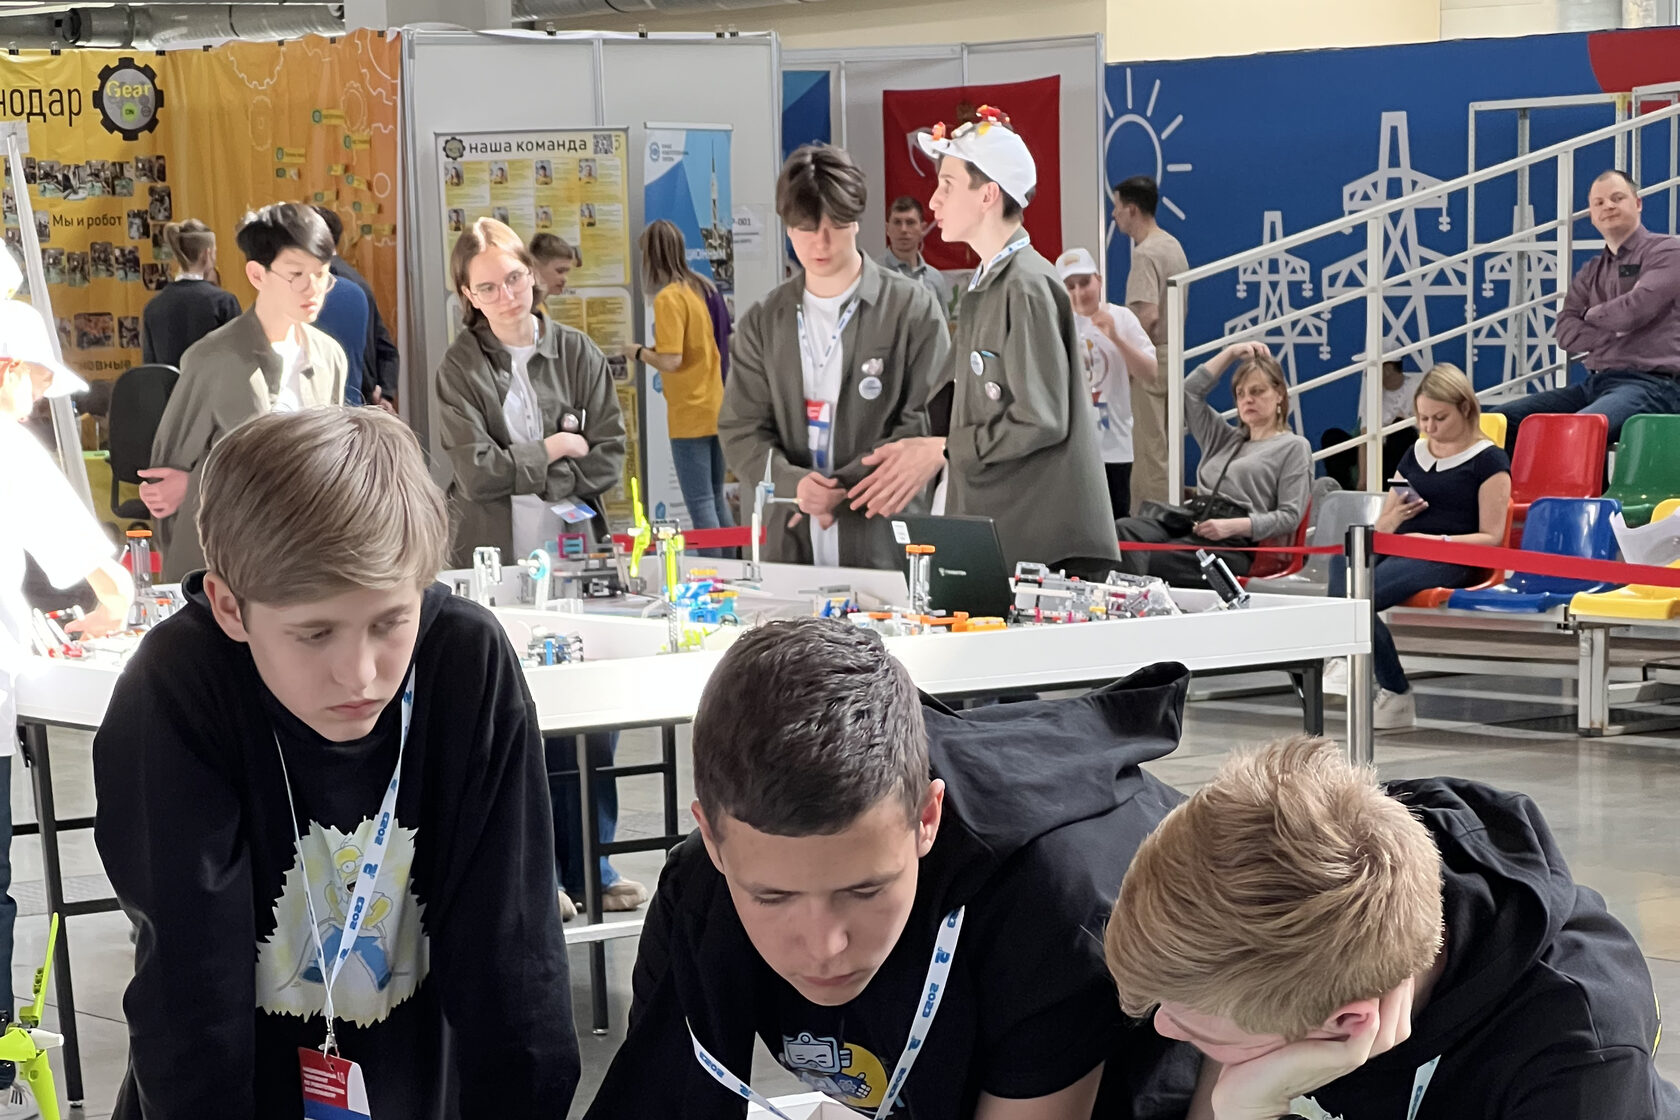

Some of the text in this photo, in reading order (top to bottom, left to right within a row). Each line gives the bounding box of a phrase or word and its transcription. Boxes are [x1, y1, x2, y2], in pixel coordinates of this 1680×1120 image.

[106, 80, 151, 98] Gear
[469, 139, 588, 154] наша команда
[53, 214, 122, 229] Мы и робот
[350, 896, 366, 930] 2023
[922, 982, 939, 1018] 2023
